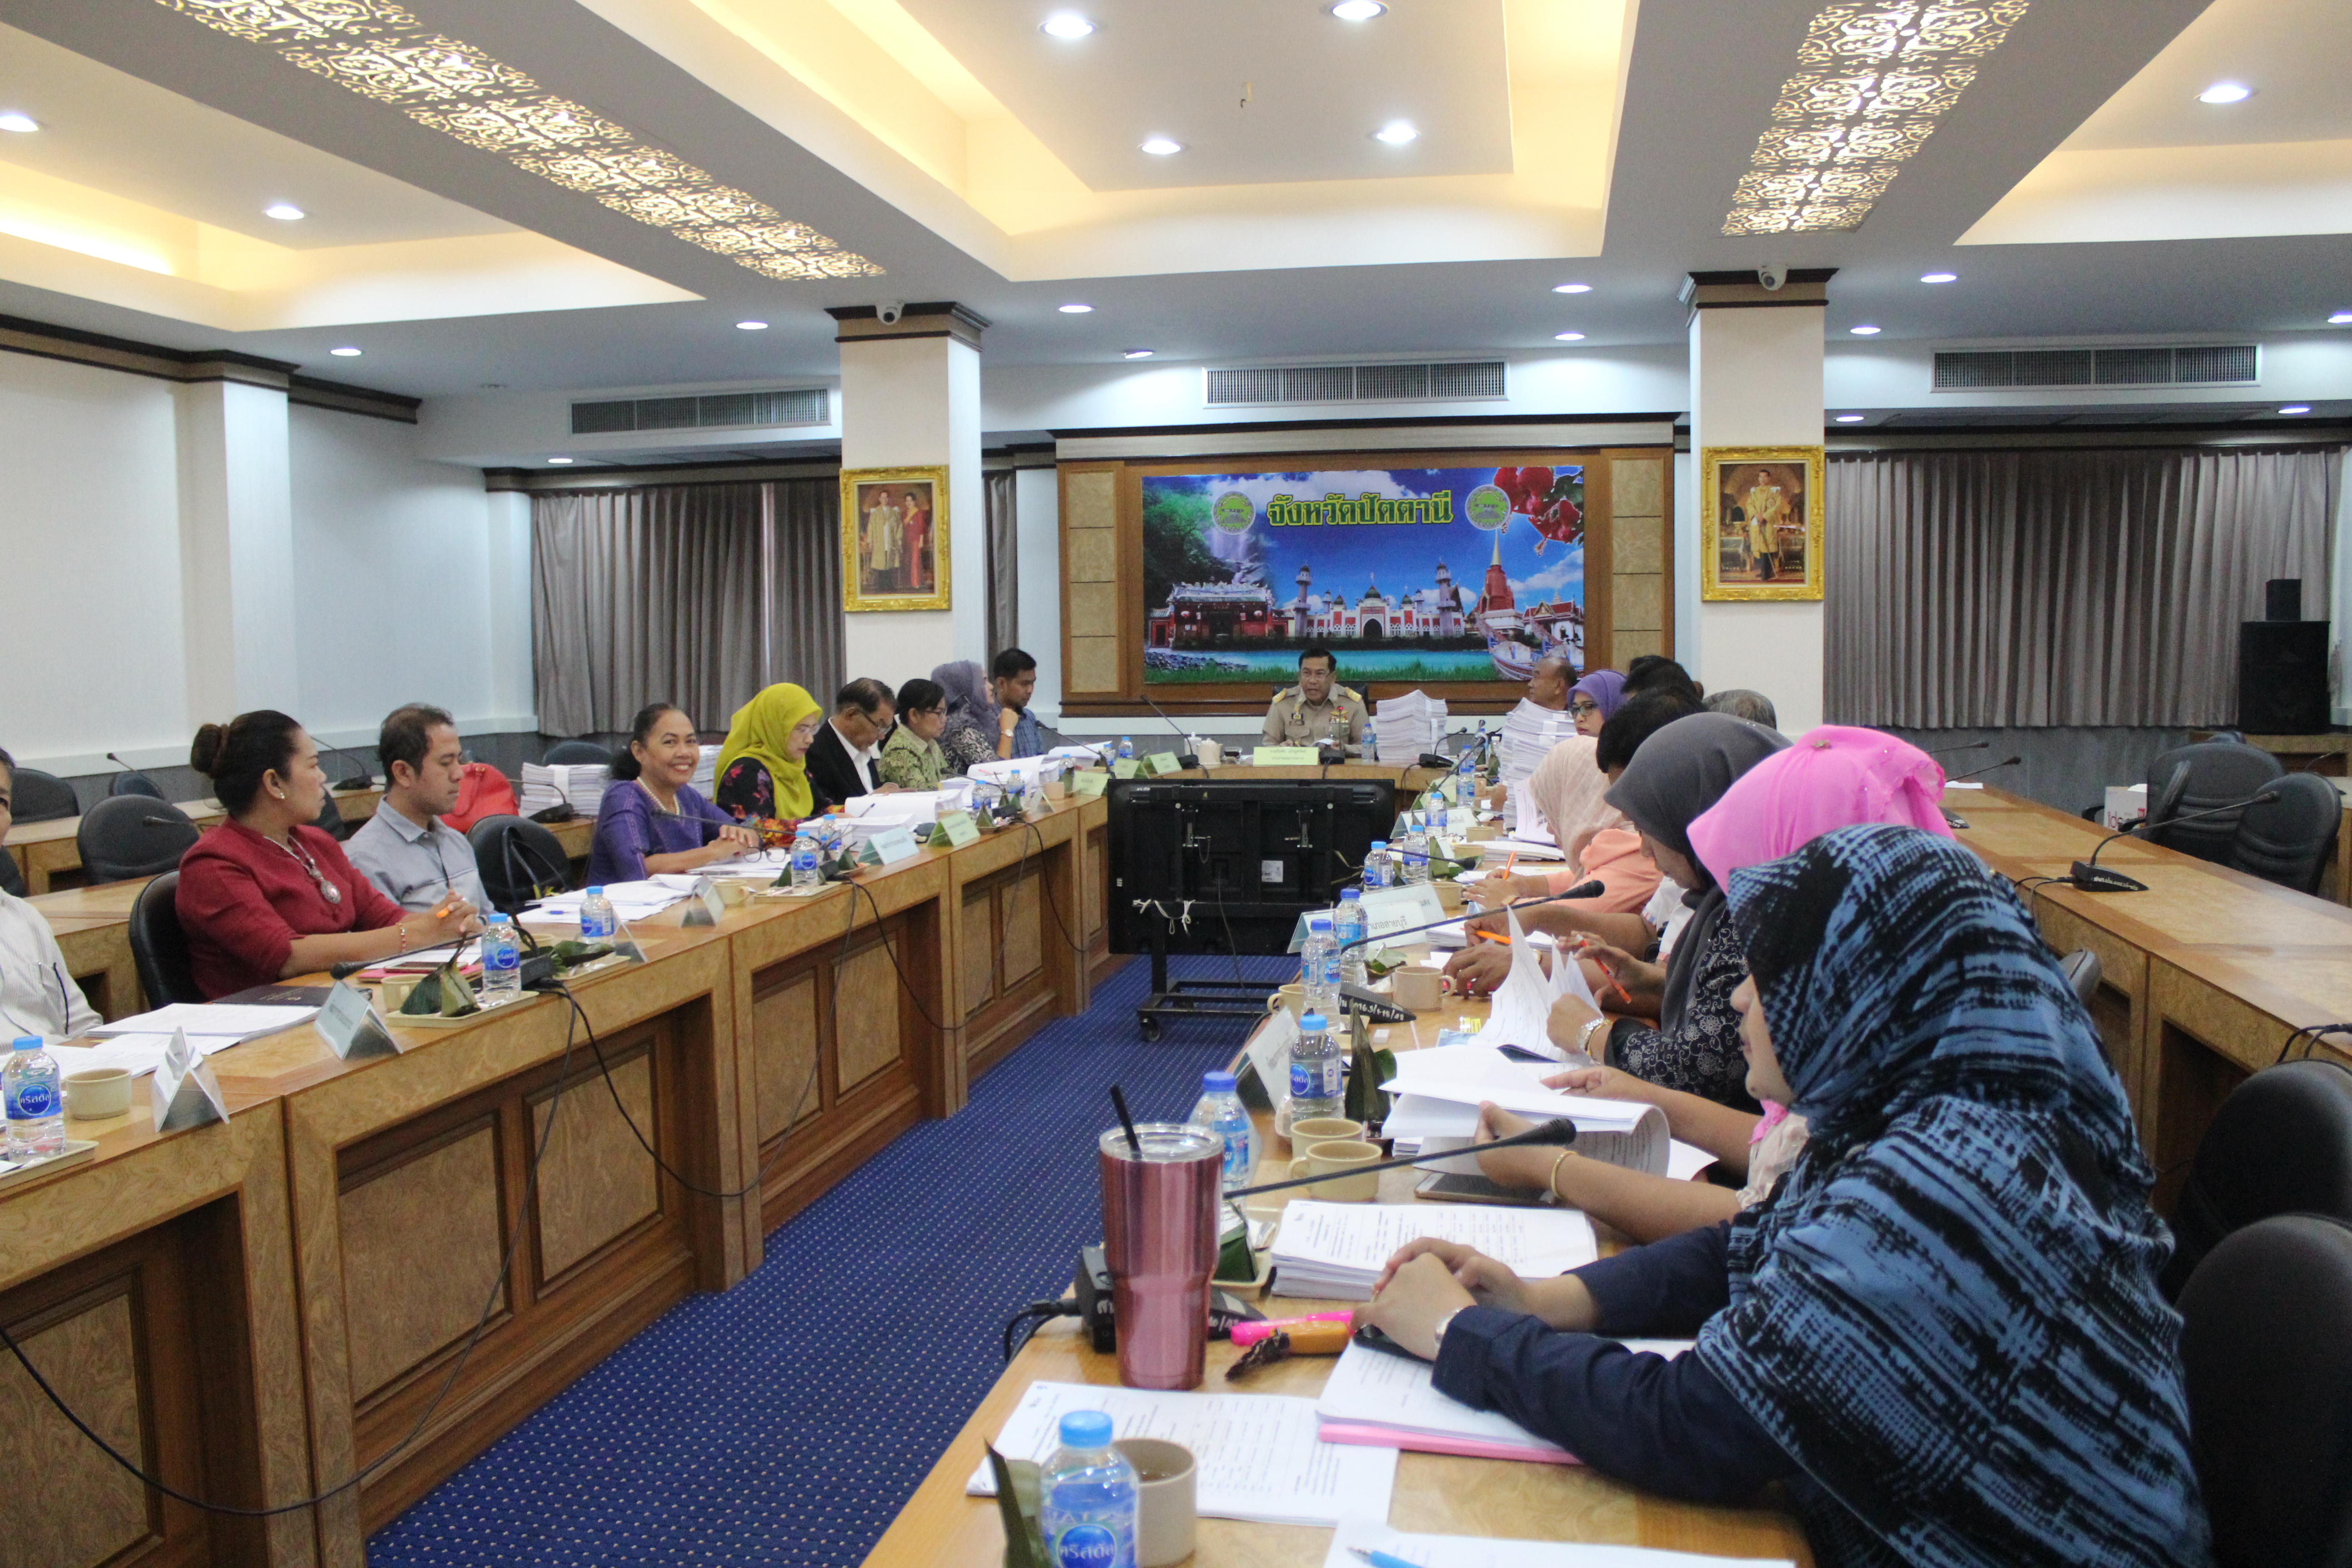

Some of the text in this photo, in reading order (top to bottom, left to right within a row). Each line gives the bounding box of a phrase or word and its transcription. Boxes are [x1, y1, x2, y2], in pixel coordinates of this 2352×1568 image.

[1267, 490, 1453, 526] จังหวัดปัตตานี
